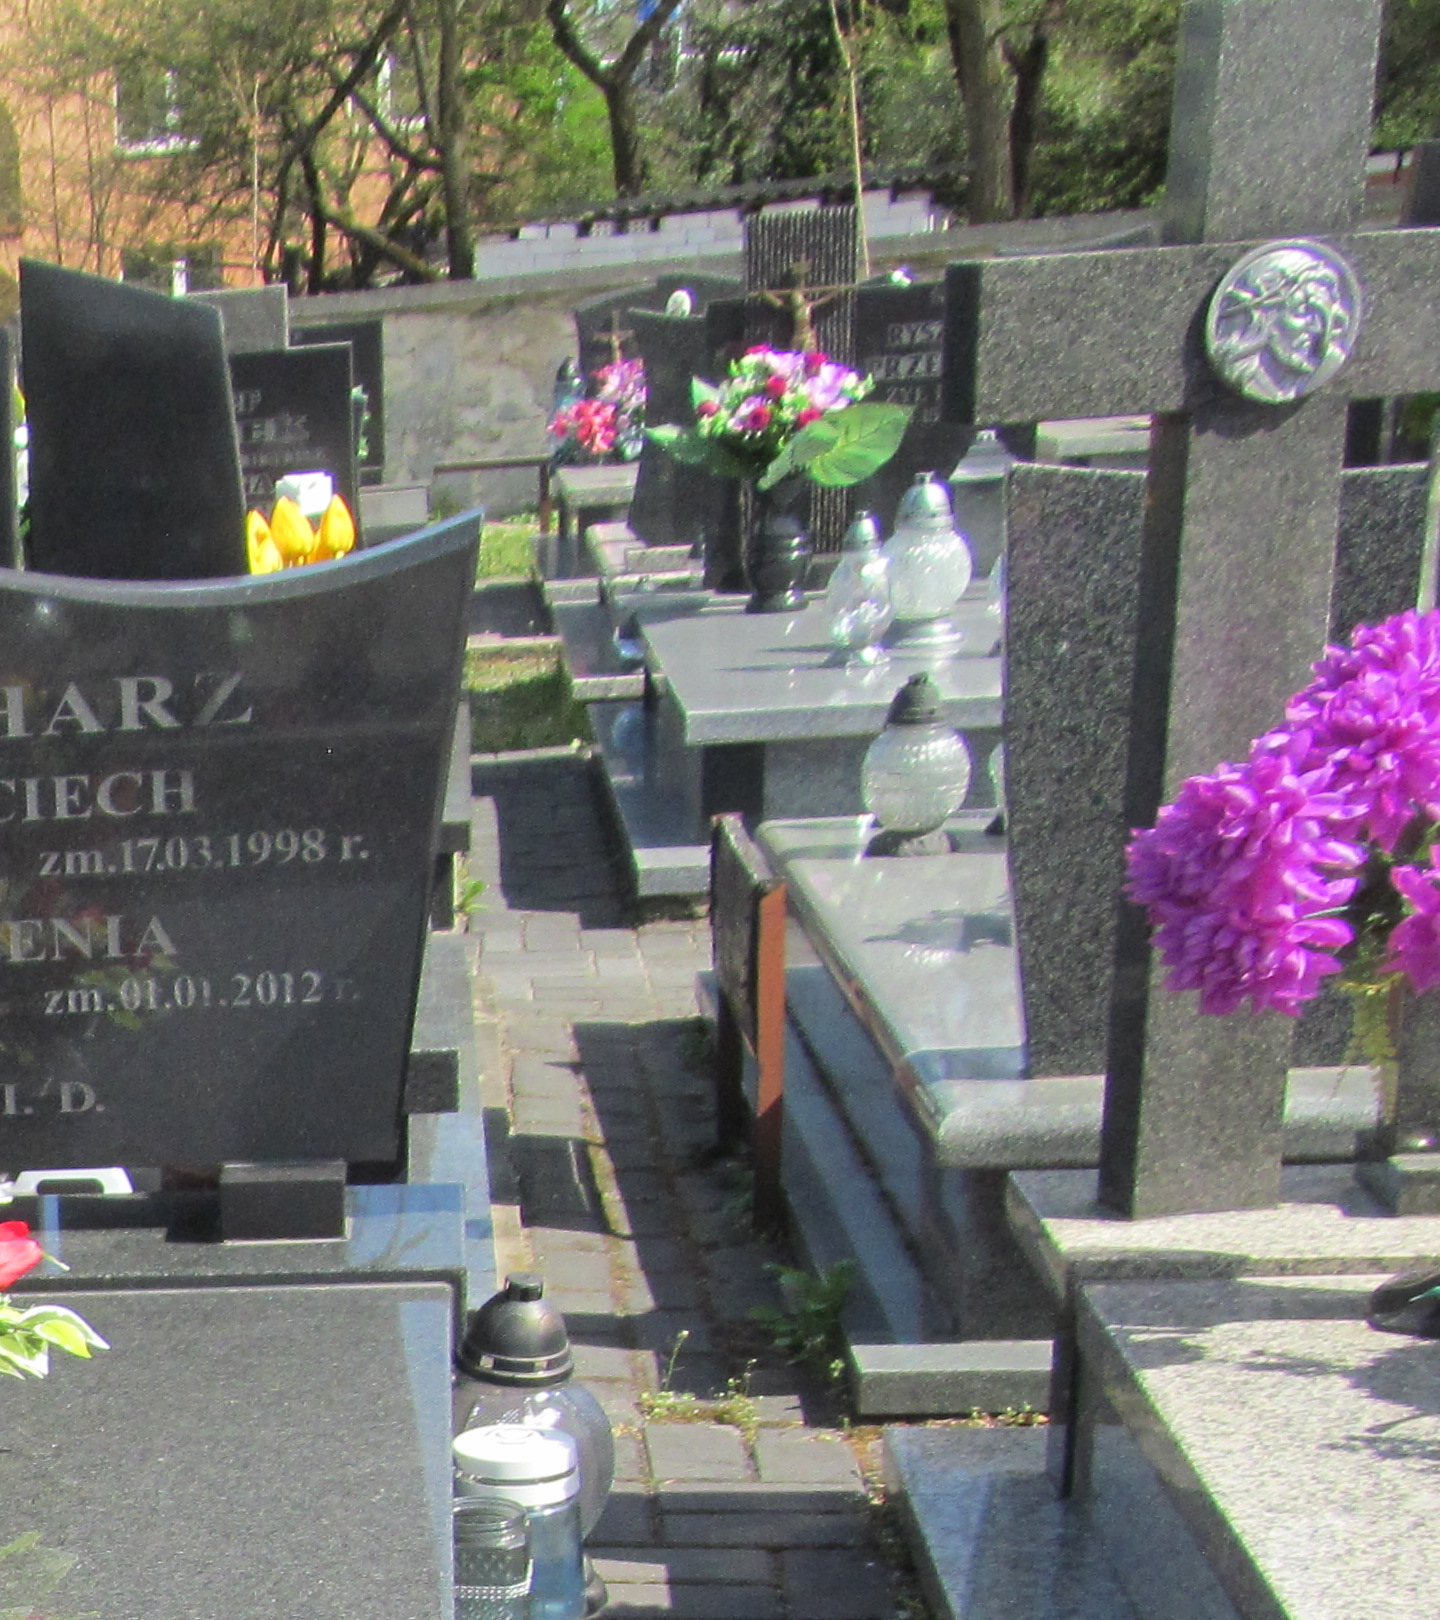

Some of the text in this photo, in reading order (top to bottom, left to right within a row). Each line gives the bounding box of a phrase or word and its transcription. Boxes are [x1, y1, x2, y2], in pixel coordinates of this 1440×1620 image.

[38, 827, 370, 876] zm.17.03.1998 r.
[43, 969, 323, 1015] zm.01.01.2012
